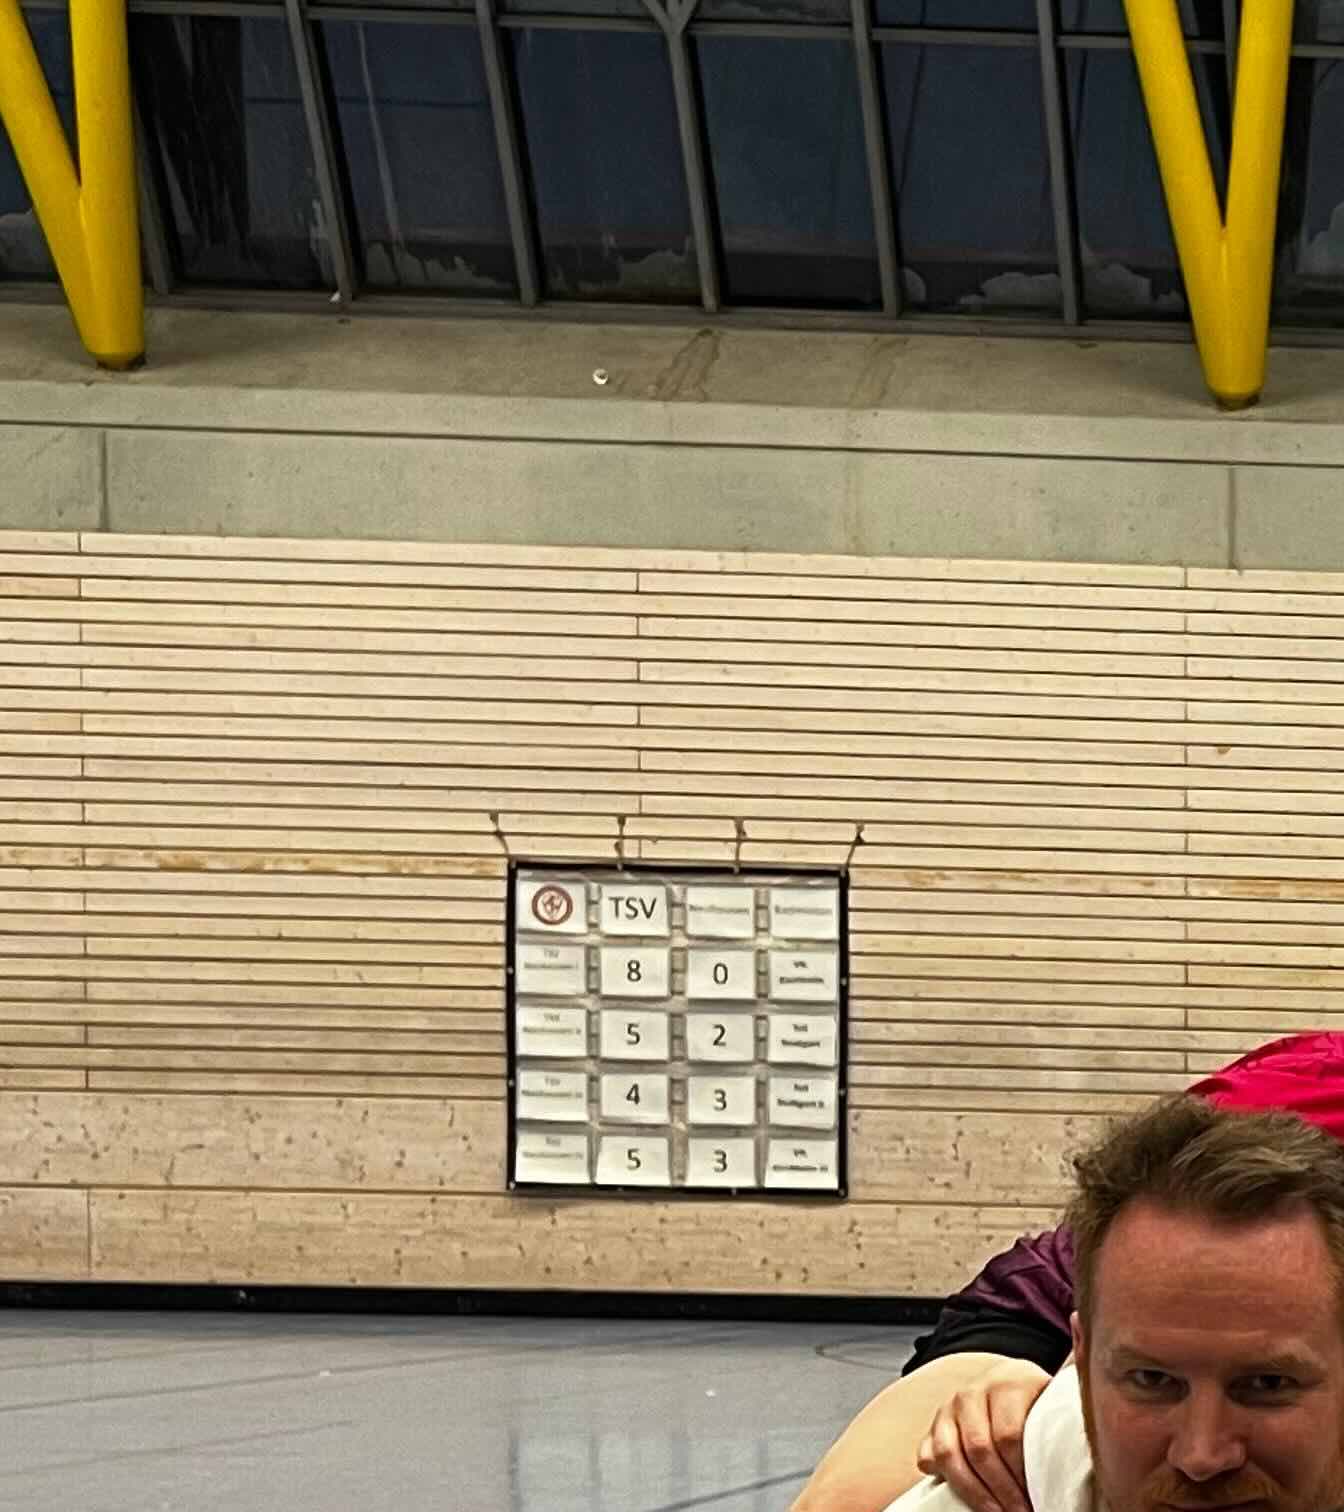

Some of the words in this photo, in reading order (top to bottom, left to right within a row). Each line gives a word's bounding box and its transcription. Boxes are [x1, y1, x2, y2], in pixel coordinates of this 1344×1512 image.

[608, 896, 658, 920] TSV
[626, 959, 642, 982] 8
[712, 962, 729, 985] 0
[626, 1023, 641, 1045] 5
[712, 1024, 727, 1047] 2
[625, 1083, 641, 1105] 4
[713, 1089, 728, 1112] 3
[626, 1148, 642, 1170] 5
[713, 1150, 728, 1173] 3
